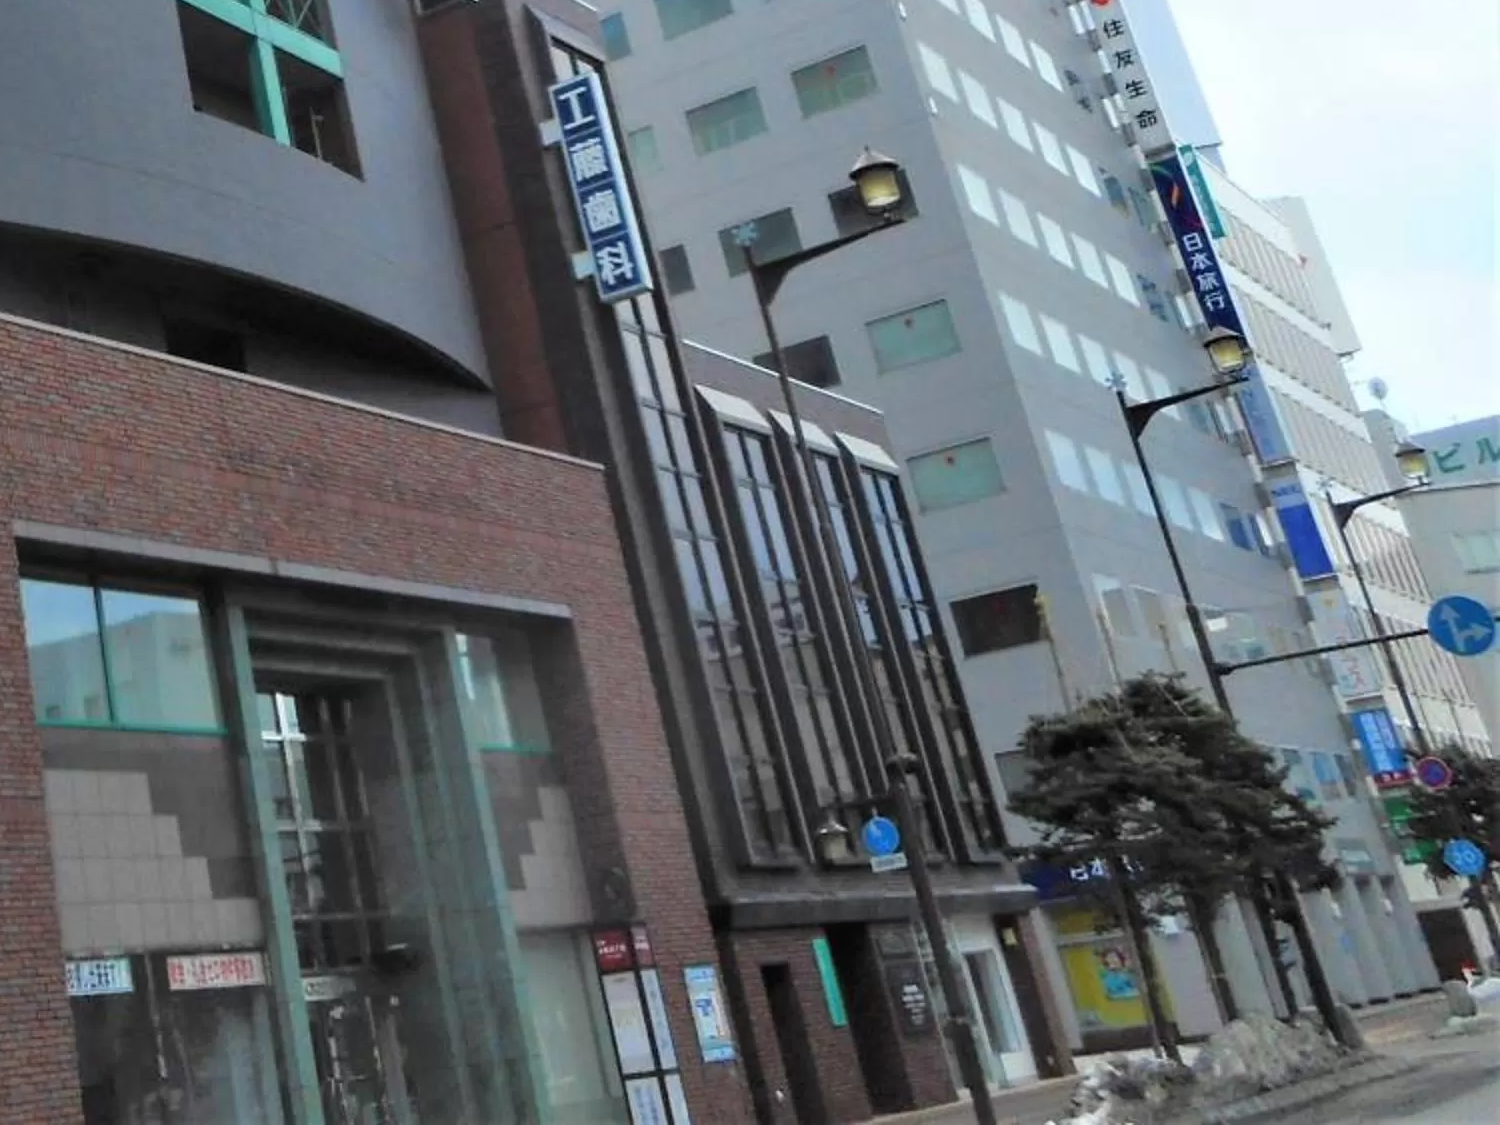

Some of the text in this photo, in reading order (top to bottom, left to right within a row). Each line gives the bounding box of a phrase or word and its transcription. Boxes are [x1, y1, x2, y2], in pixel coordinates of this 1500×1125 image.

[1102, 18, 1158, 129] 住友生命
[1182, 232, 1226, 311] 日本旅行
